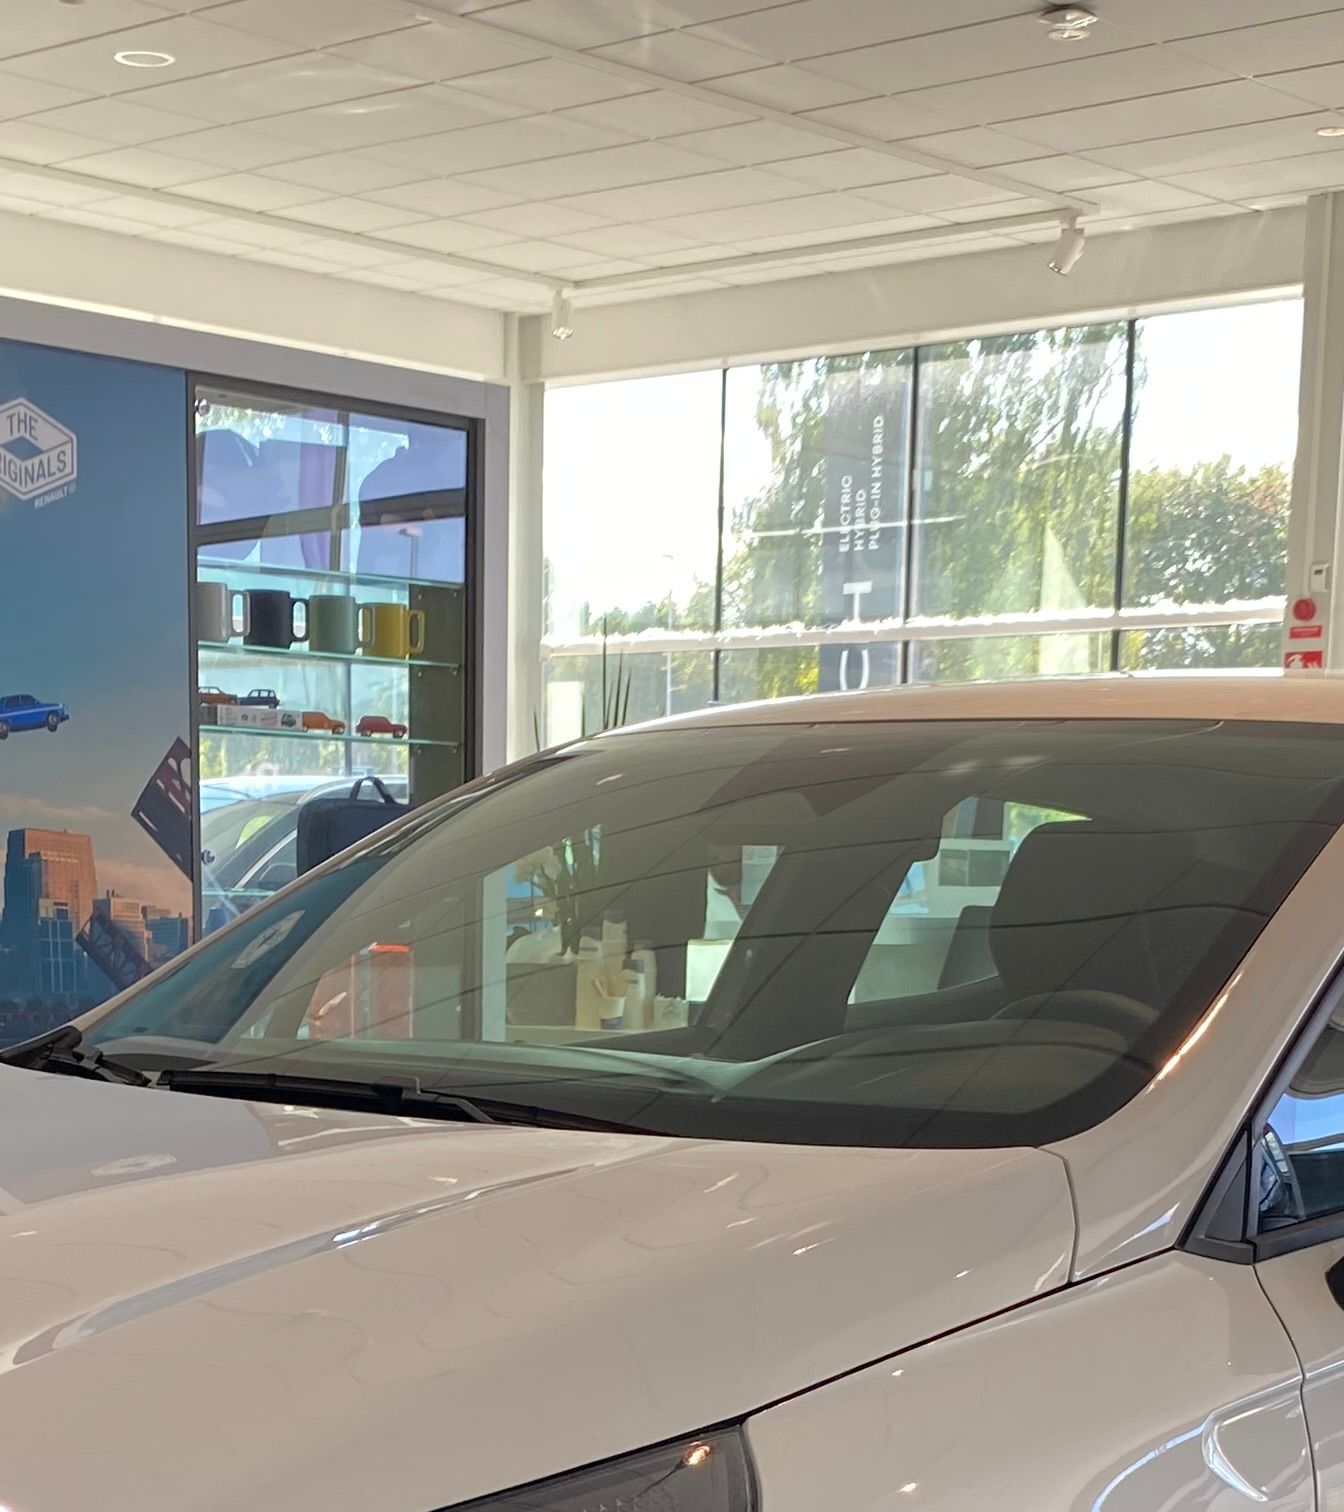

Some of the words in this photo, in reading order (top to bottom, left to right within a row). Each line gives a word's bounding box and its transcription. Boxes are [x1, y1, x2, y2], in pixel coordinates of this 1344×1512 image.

[7, 411, 38, 440] THE
[871, 415, 885, 478] HYBRID
[854, 489, 866, 551] HYBRID
